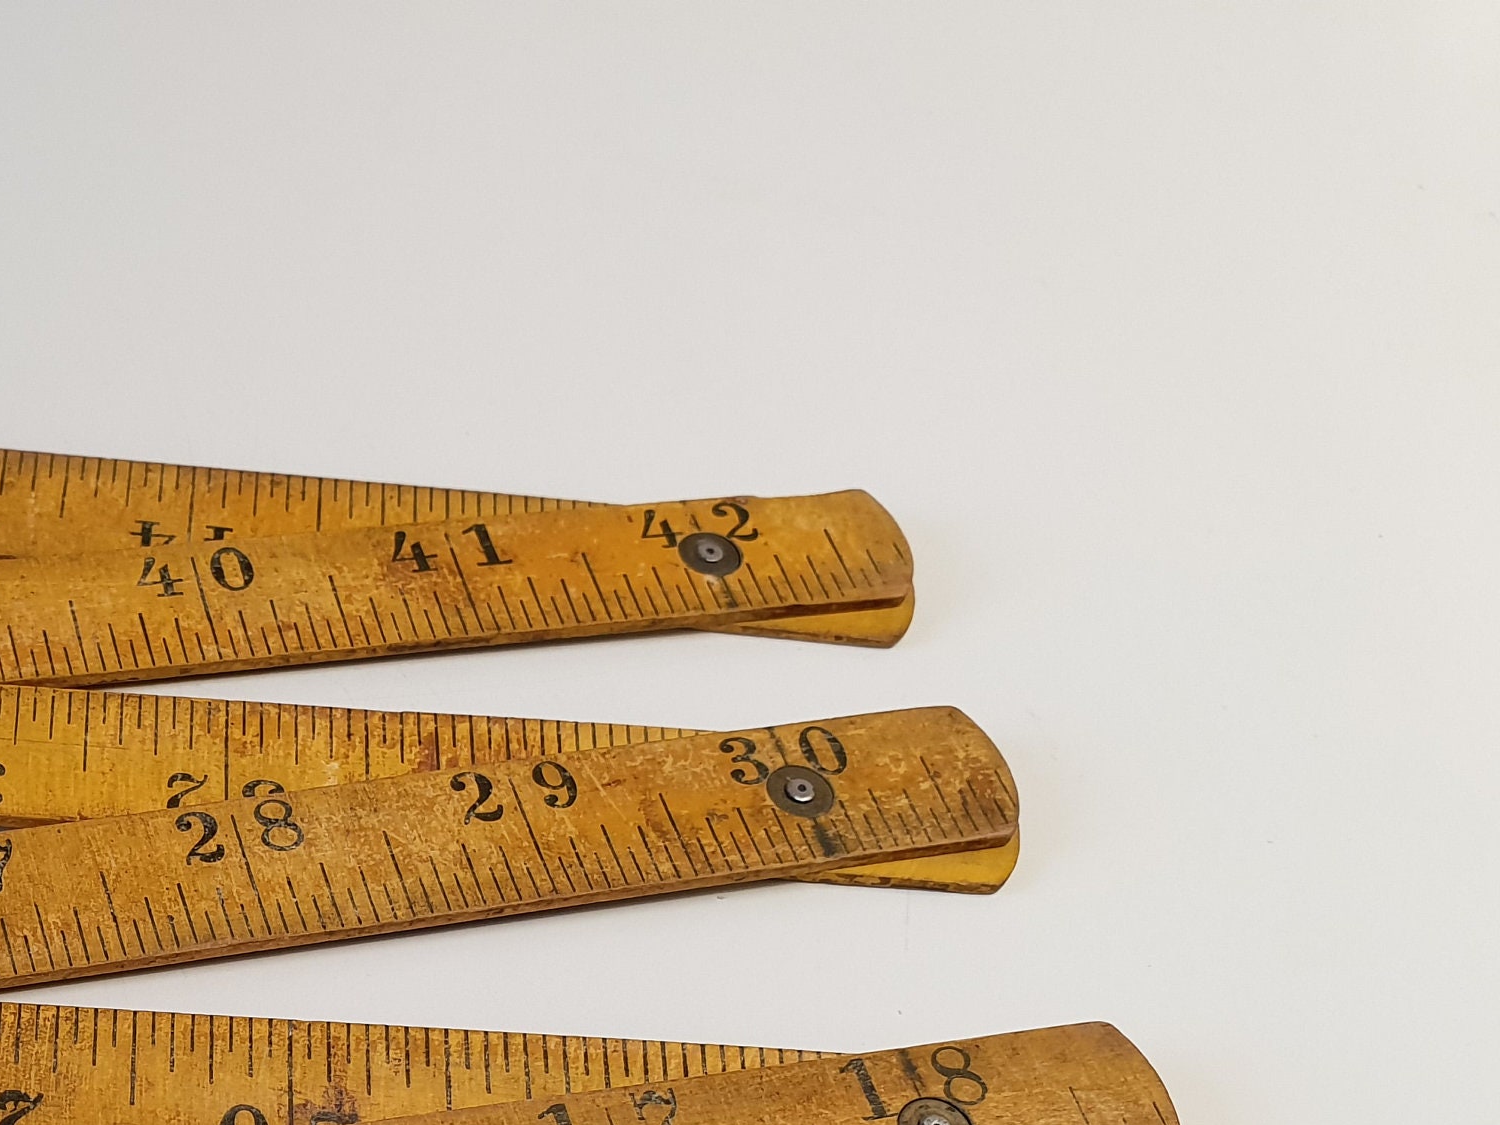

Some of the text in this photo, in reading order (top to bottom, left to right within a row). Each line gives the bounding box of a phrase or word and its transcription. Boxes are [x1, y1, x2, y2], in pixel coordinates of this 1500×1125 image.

[392, 523, 513, 573] 41
[640, 502, 758, 549] 42
[137, 547, 254, 597] 40
[718, 725, 847, 785] 30
[450, 760, 578, 825] 29
[175, 799, 305, 865] 28
[839, 1045, 987, 1121] 18
